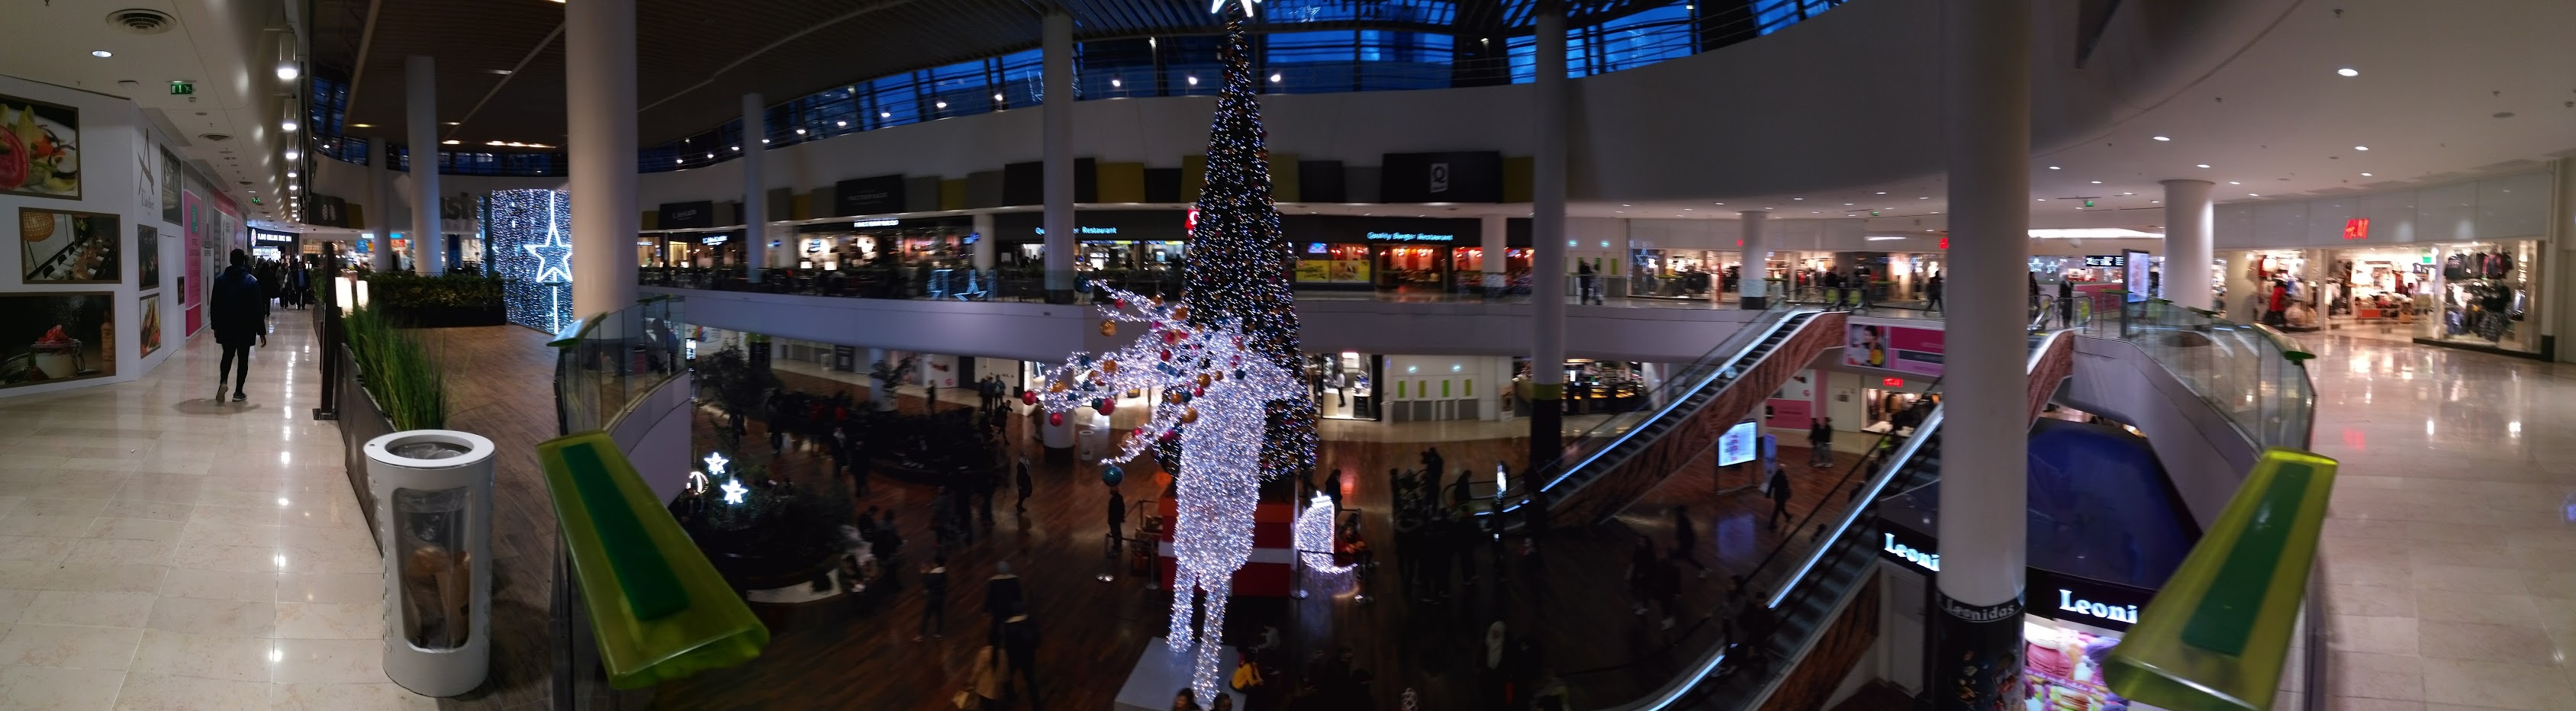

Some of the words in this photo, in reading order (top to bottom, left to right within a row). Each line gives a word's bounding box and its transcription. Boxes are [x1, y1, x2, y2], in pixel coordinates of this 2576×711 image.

[1081, 226, 1117, 234] Restaurant
[1367, 231, 1393, 241] Quality
[1393, 232, 1416, 241] Burger
[1416, 233, 1454, 241] Restaurant
[1946, 598, 2015, 620] Leonidas
[2059, 589, 2138, 624] Leoni
